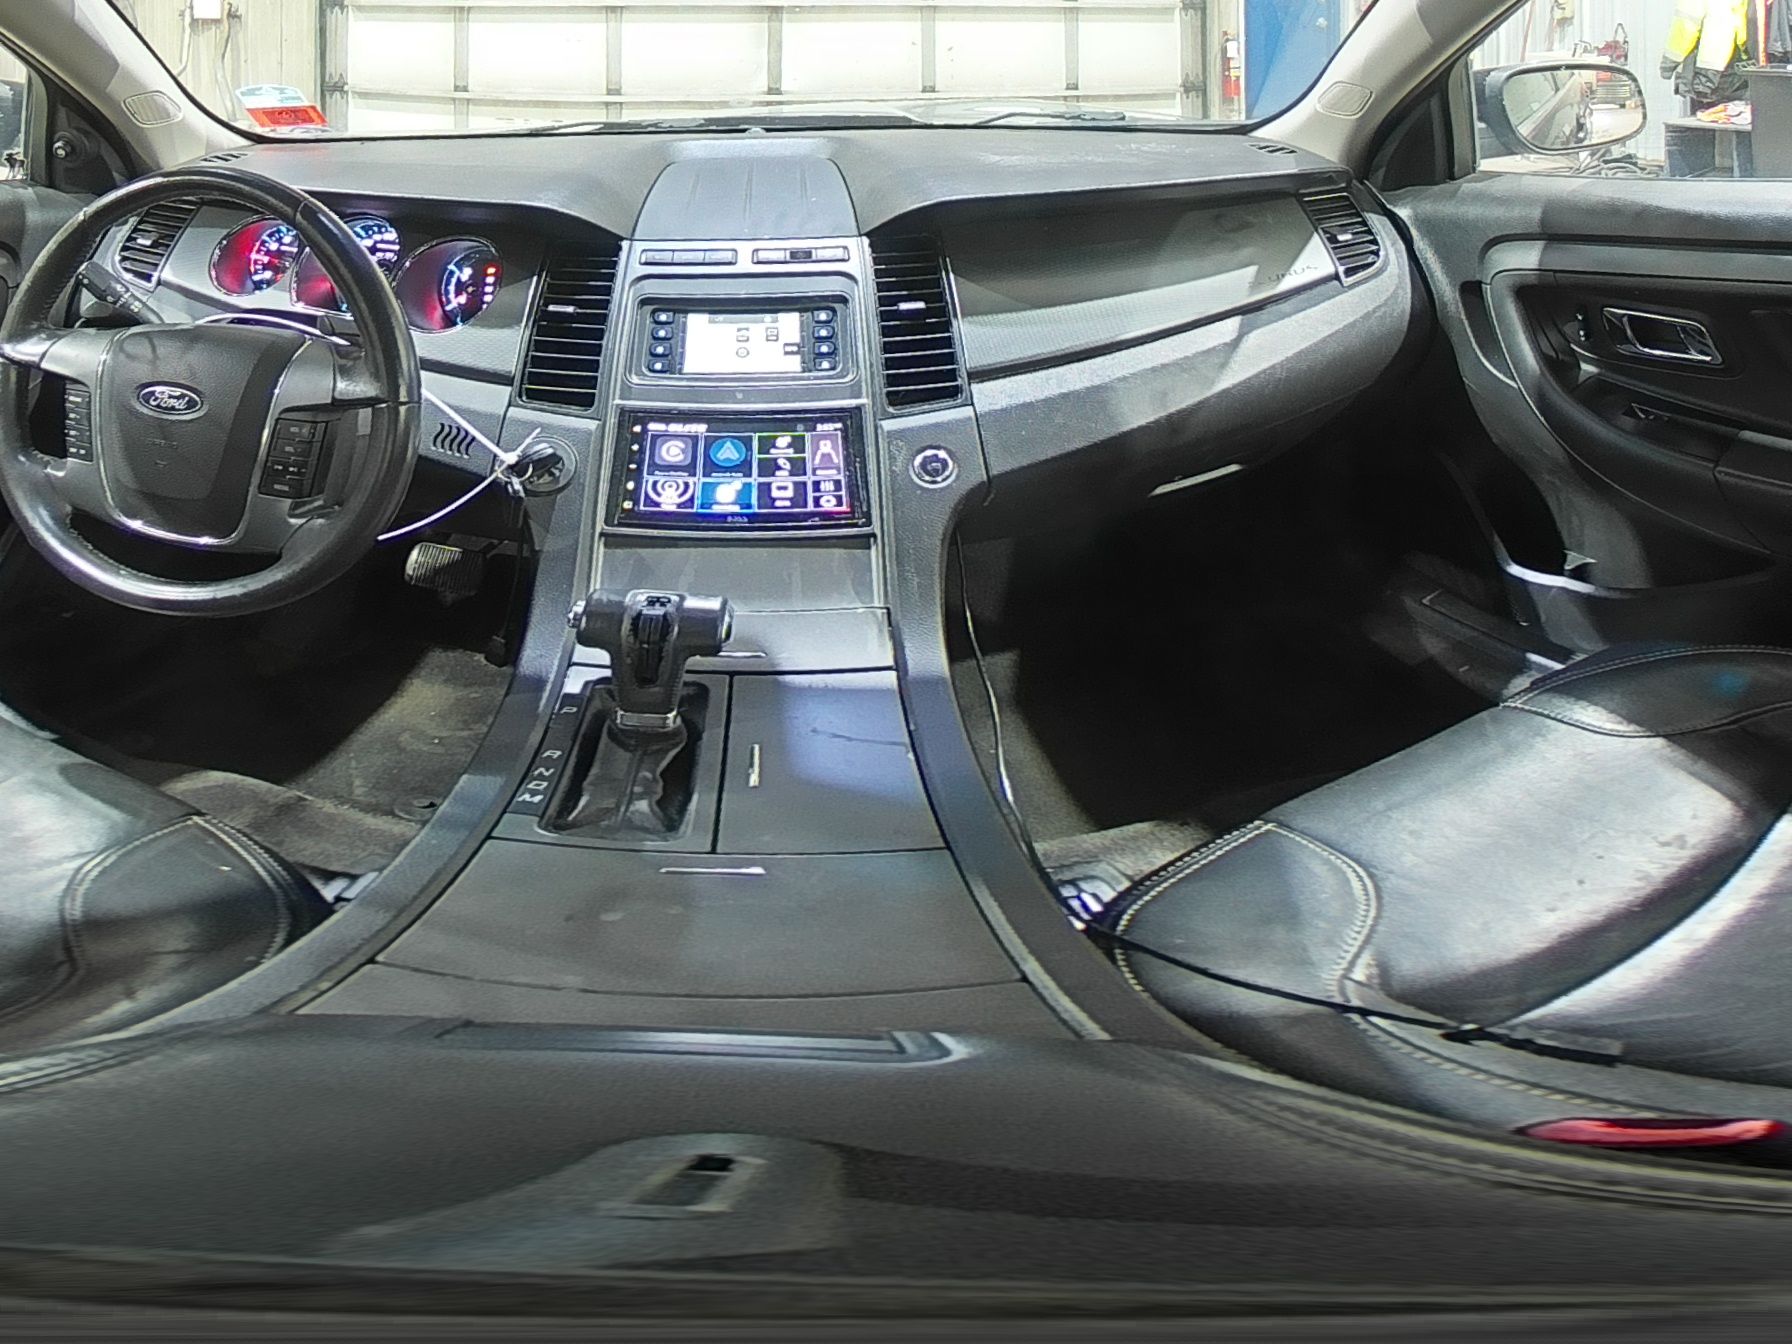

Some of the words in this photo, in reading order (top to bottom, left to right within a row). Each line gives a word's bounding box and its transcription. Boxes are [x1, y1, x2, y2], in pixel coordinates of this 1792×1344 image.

[148, 388, 190, 410] Ford
[560, 706, 578, 714] P
[531, 767, 555, 777] N
[526, 780, 549, 791] D
[516, 792, 545, 803] M
